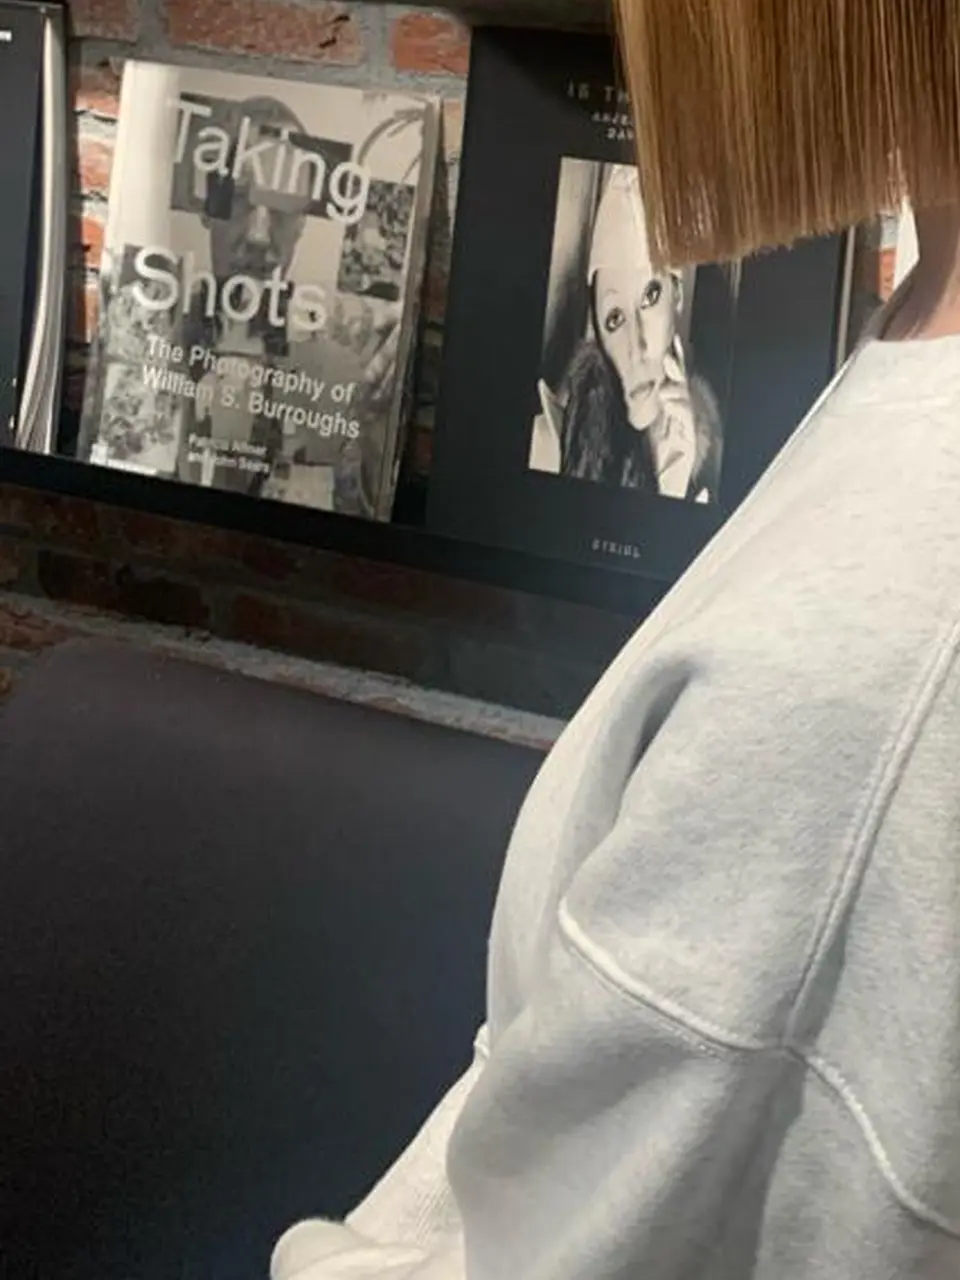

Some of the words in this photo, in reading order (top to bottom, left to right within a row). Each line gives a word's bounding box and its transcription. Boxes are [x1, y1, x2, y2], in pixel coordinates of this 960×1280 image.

[169, 98, 372, 223] Taking
[132, 245, 330, 332] Shots
[142, 364, 214, 402] William
[220, 385, 241, 409] S.
[248, 390, 361, 439] Burroughs
[146, 333, 184, 363] The
[189, 345, 326, 402] Photography
[330, 382, 357, 405] of
